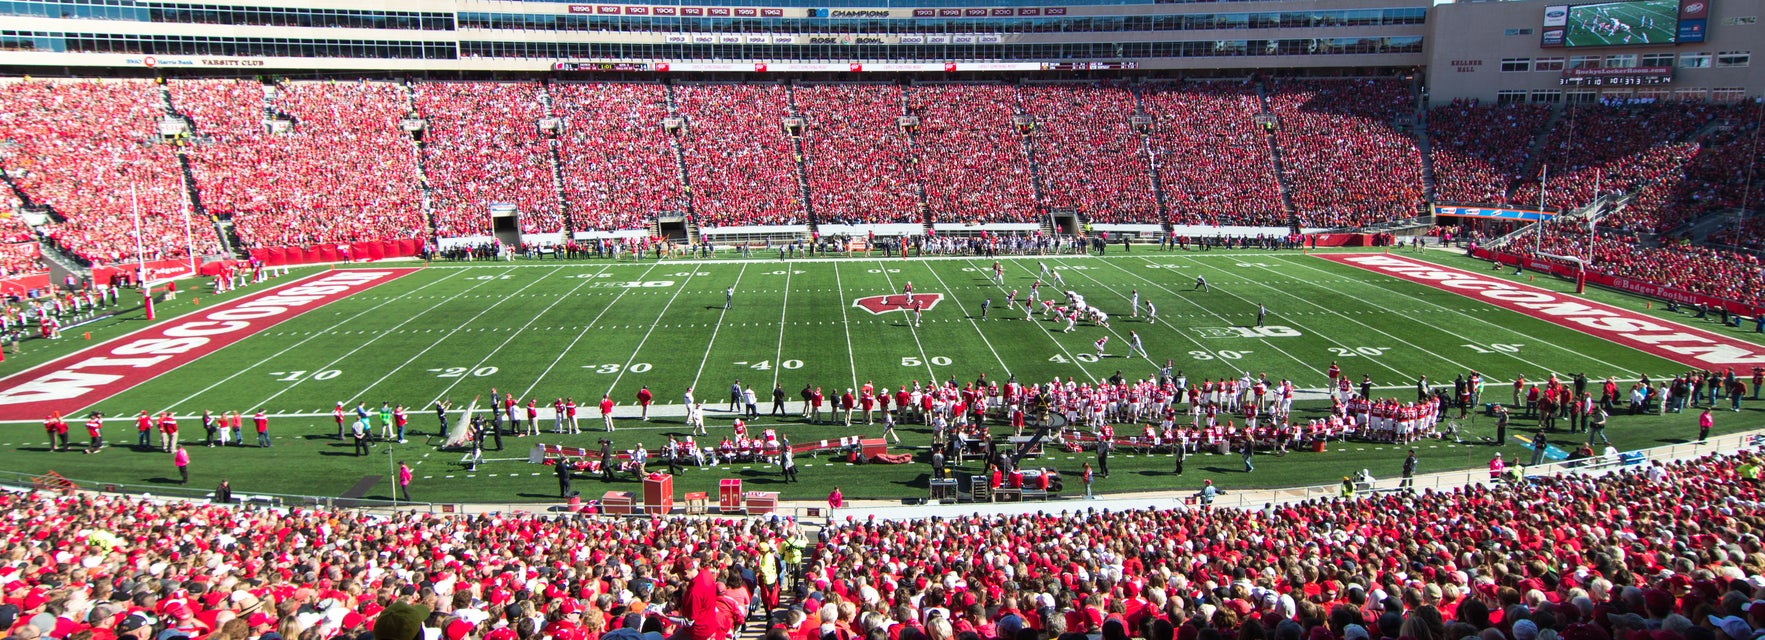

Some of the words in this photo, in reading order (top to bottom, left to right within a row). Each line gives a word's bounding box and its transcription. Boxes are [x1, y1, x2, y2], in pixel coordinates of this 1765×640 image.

[1343, 255, 1765, 365] WISCONSIN
[0, 271, 393, 404] WISCONSIN
[1188, 350, 1244, 360] 30
[1328, 346, 1383, 357] 20
[901, 356, 953, 367] 50
[1048, 353, 1099, 364] 40
[596, 363, 653, 374] 30
[750, 360, 804, 370] 40
[277, 369, 342, 382] 10
[436, 366, 499, 378] 20
